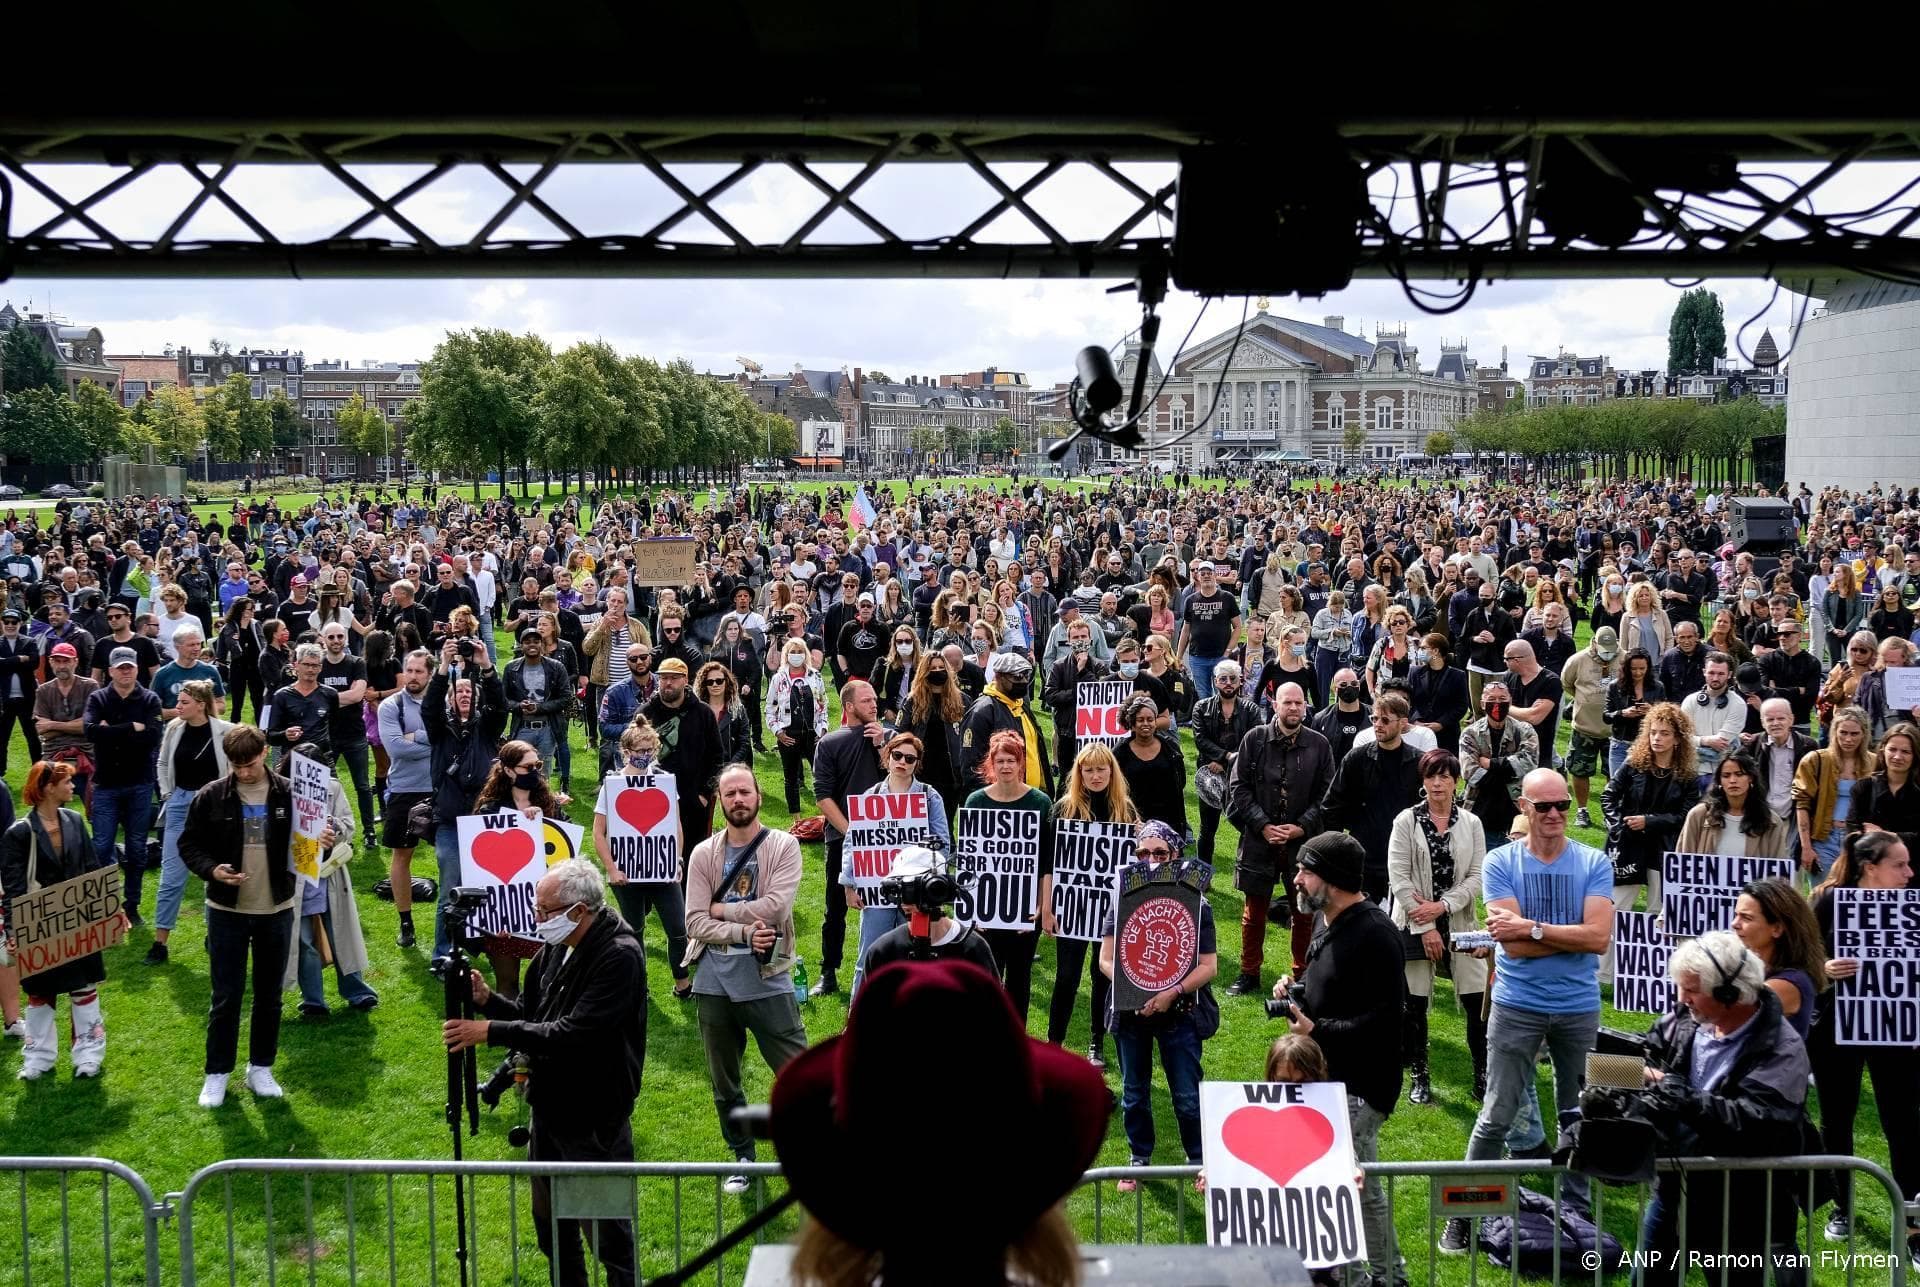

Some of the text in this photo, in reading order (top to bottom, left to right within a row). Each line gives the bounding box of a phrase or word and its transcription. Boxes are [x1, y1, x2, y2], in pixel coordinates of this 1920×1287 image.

[1077, 707, 1129, 736] NO
[307, 763, 322, 783] DOE
[625, 775, 657, 788] WE
[848, 794, 927, 821] LOVE
[483, 814, 518, 829] WE
[887, 820, 900, 828] THE
[959, 810, 1038, 840] MUSIC
[1058, 819, 1137, 838] LET THE
[852, 827, 928, 846] MESSAGE
[958, 839, 1037, 855] IS GOOD
[611, 834, 677, 880] PARADISO
[958, 854, 1035, 874] FOR YOUR
[1055, 833, 1138, 874] MUSIC
[1056, 870, 1115, 889] TAK
[1665, 853, 1792, 887] GEEN LEVEN
[13, 869, 121, 924] THE CURVE
[956, 871, 1035, 924] SOUL
[1839, 889, 1857, 901] IK
[1863, 890, 1899, 902] BEN
[16, 894, 120, 948] FLATTENED
[1838, 903, 1920, 930] FEES
[17, 914, 124, 977] NOW WHAT?
[1127, 924, 1141, 944] DE
[1138, 905, 1180, 926] NACHT
[1175, 916, 1190, 968] WACHT
[1837, 931, 1920, 947] BEES
[1839, 948, 1860, 958] IK
[1866, 948, 1907, 959] BEN
[1837, 960, 1920, 997] NACH
[1616, 976, 1678, 1013] MACH
[1838, 1000, 1920, 1042] VLIND
[1243, 1084, 1304, 1103] WE
[1211, 1185, 1358, 1262] PARADISO
